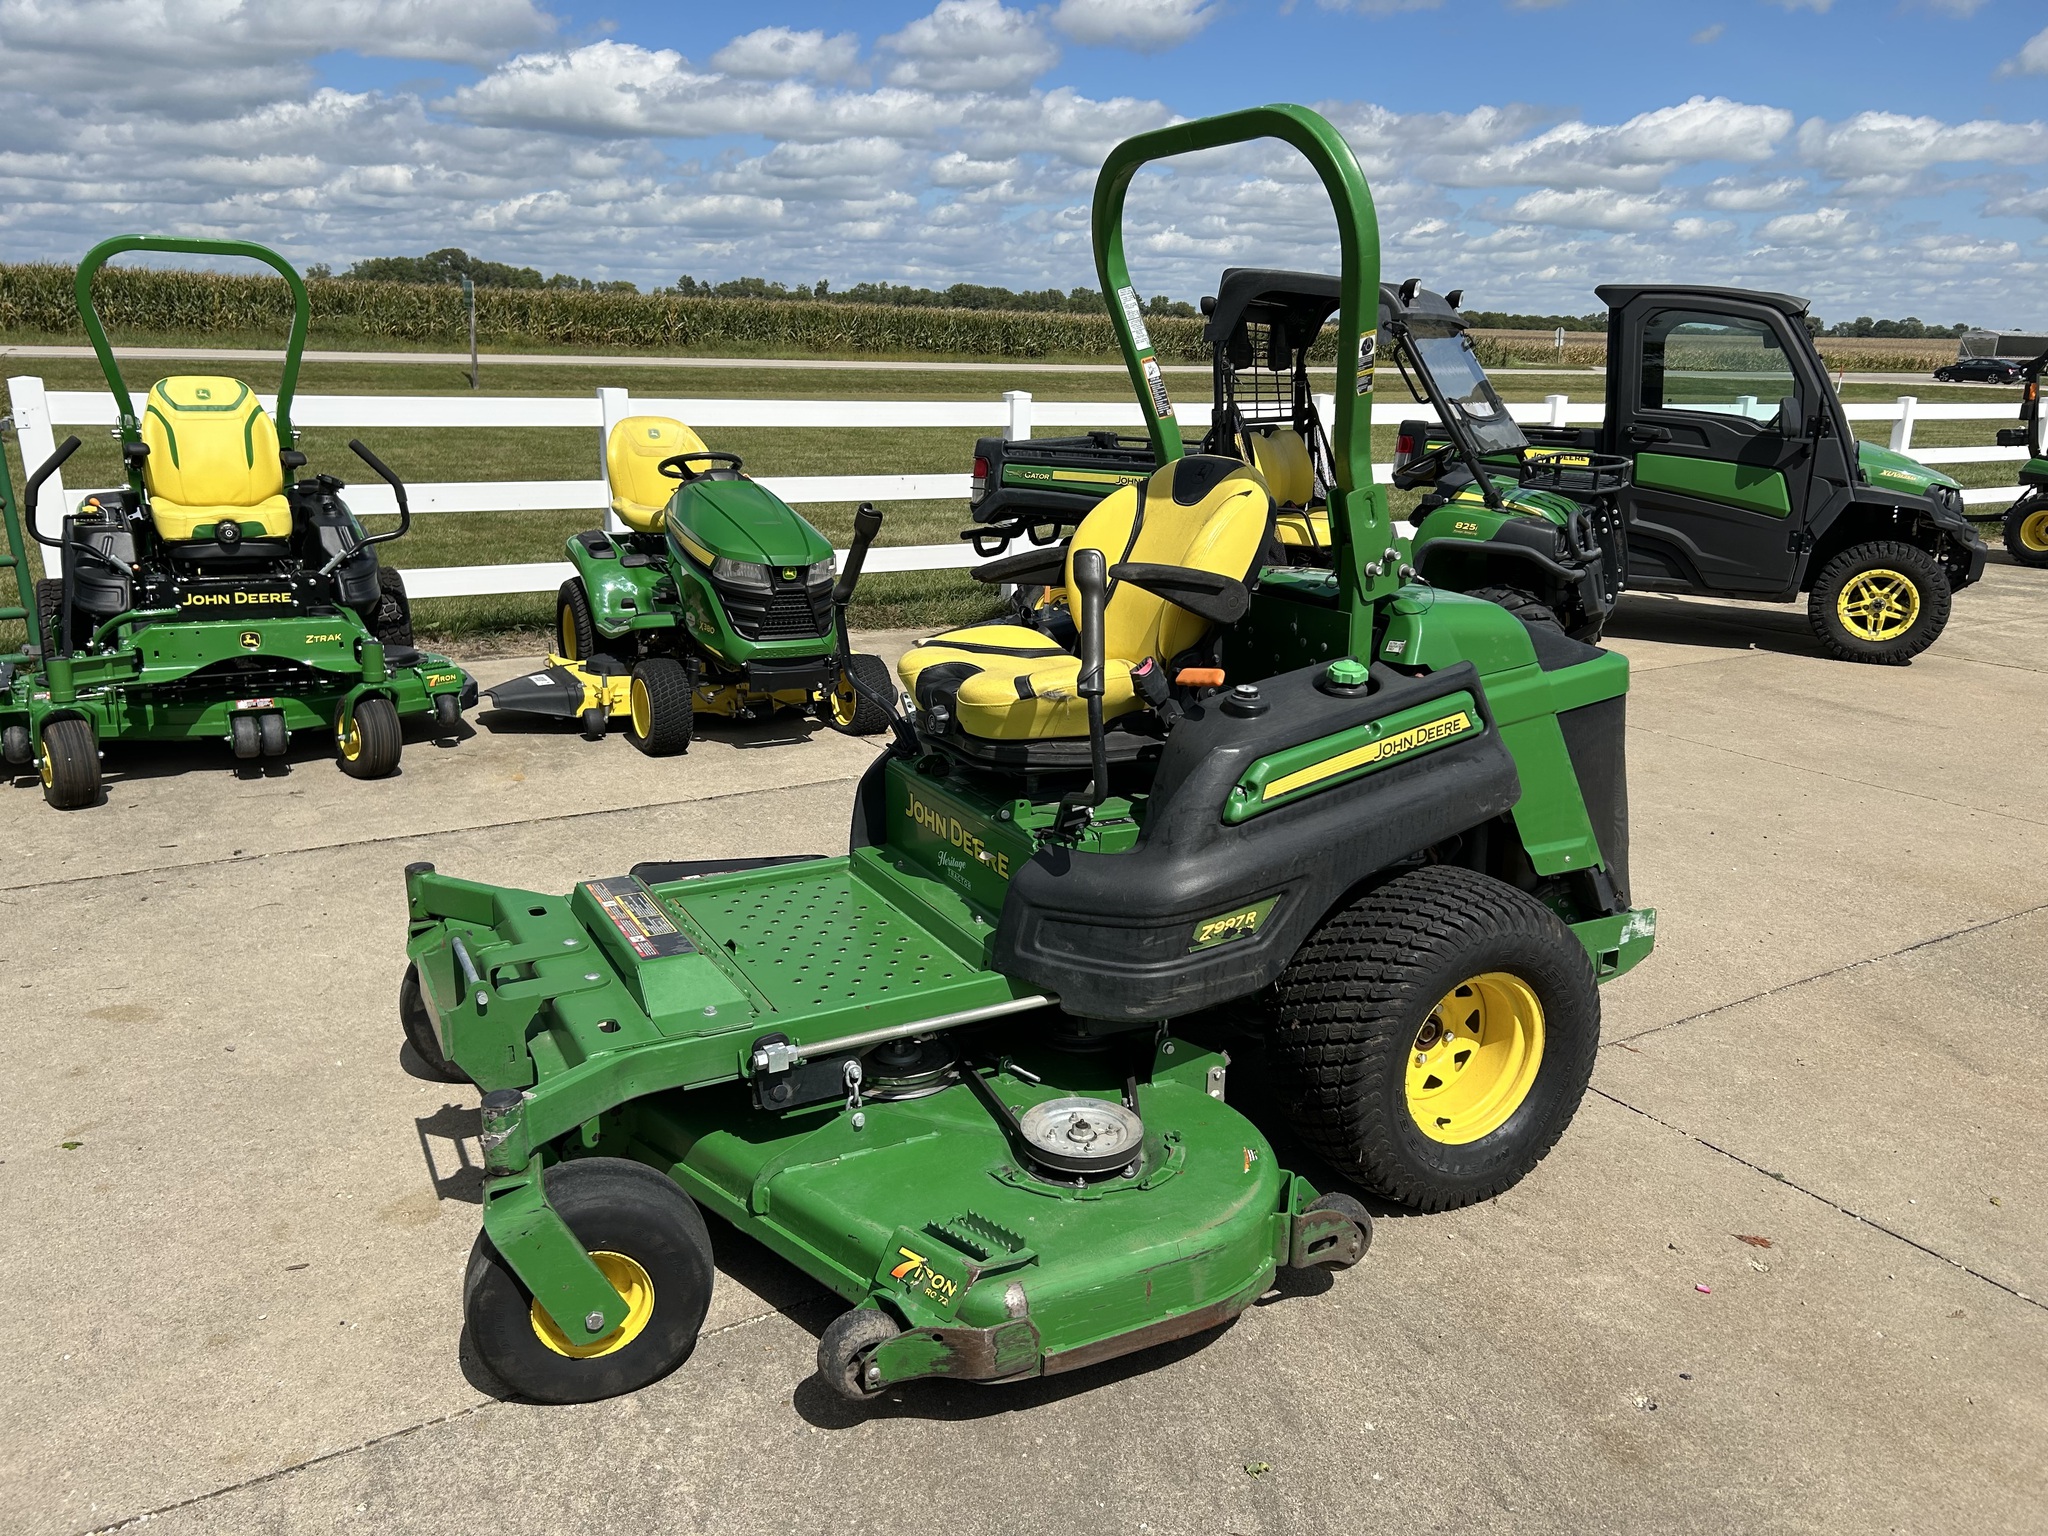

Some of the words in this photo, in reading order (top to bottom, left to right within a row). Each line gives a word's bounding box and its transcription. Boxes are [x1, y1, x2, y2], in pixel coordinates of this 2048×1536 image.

[1024, 471, 1050, 480] GATOR
[182, 593, 231, 606] JOHN
[234, 592, 292, 604] DEERE
[305, 633, 342, 644] ZTRAK
[1373, 735, 1413, 760] JOHN
[1416, 718, 1462, 745] DEERE
[905, 792, 947, 840] JOHN
[950, 817, 1009, 880] DEERE
[937, 850, 967, 872] Heritage
[1199, 911, 1257, 942] Z997R
